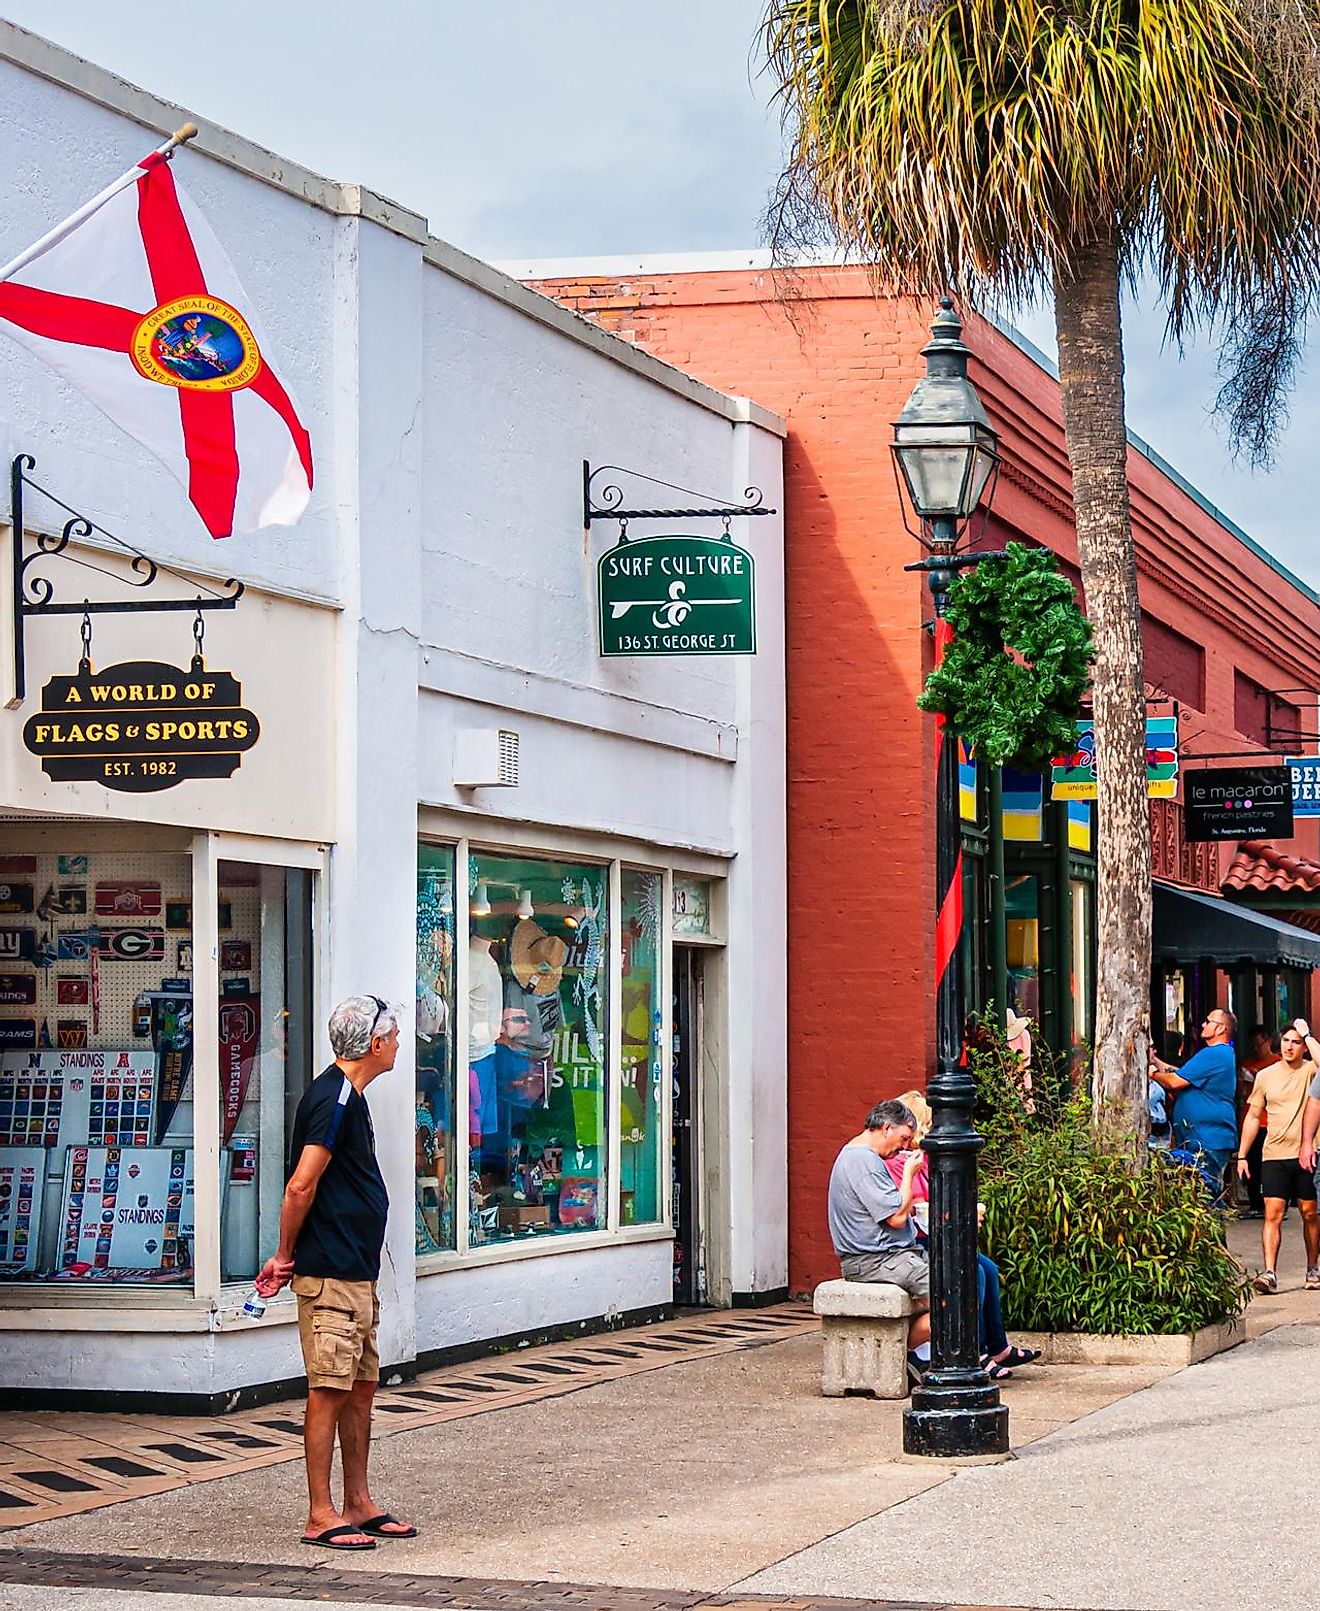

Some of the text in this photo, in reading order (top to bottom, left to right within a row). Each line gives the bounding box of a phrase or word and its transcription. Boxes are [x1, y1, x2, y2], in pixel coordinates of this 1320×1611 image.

[148, 307, 176, 327] GREAT
[179, 300, 205, 309] SEAL
[207, 302, 220, 312] OF
[223, 311, 239, 323] THE
[608, 556, 743, 576] SURF CULTURE
[618, 636, 641, 649] 136
[662, 634, 716, 649] GEORGE
[720, 634, 736, 648] ST
[65, 683, 216, 702] A WORLD OF
[35, 721, 248, 742] FLAGS & SPORTS
[104, 762, 176, 776] EST. 1982
[1192, 784, 1285, 799] le macaron
[60, 1053, 105, 1068] STANDINGS
[226, 1044, 242, 1118] GAMECOCKS
[118, 1208, 165, 1224] STANDINGS
